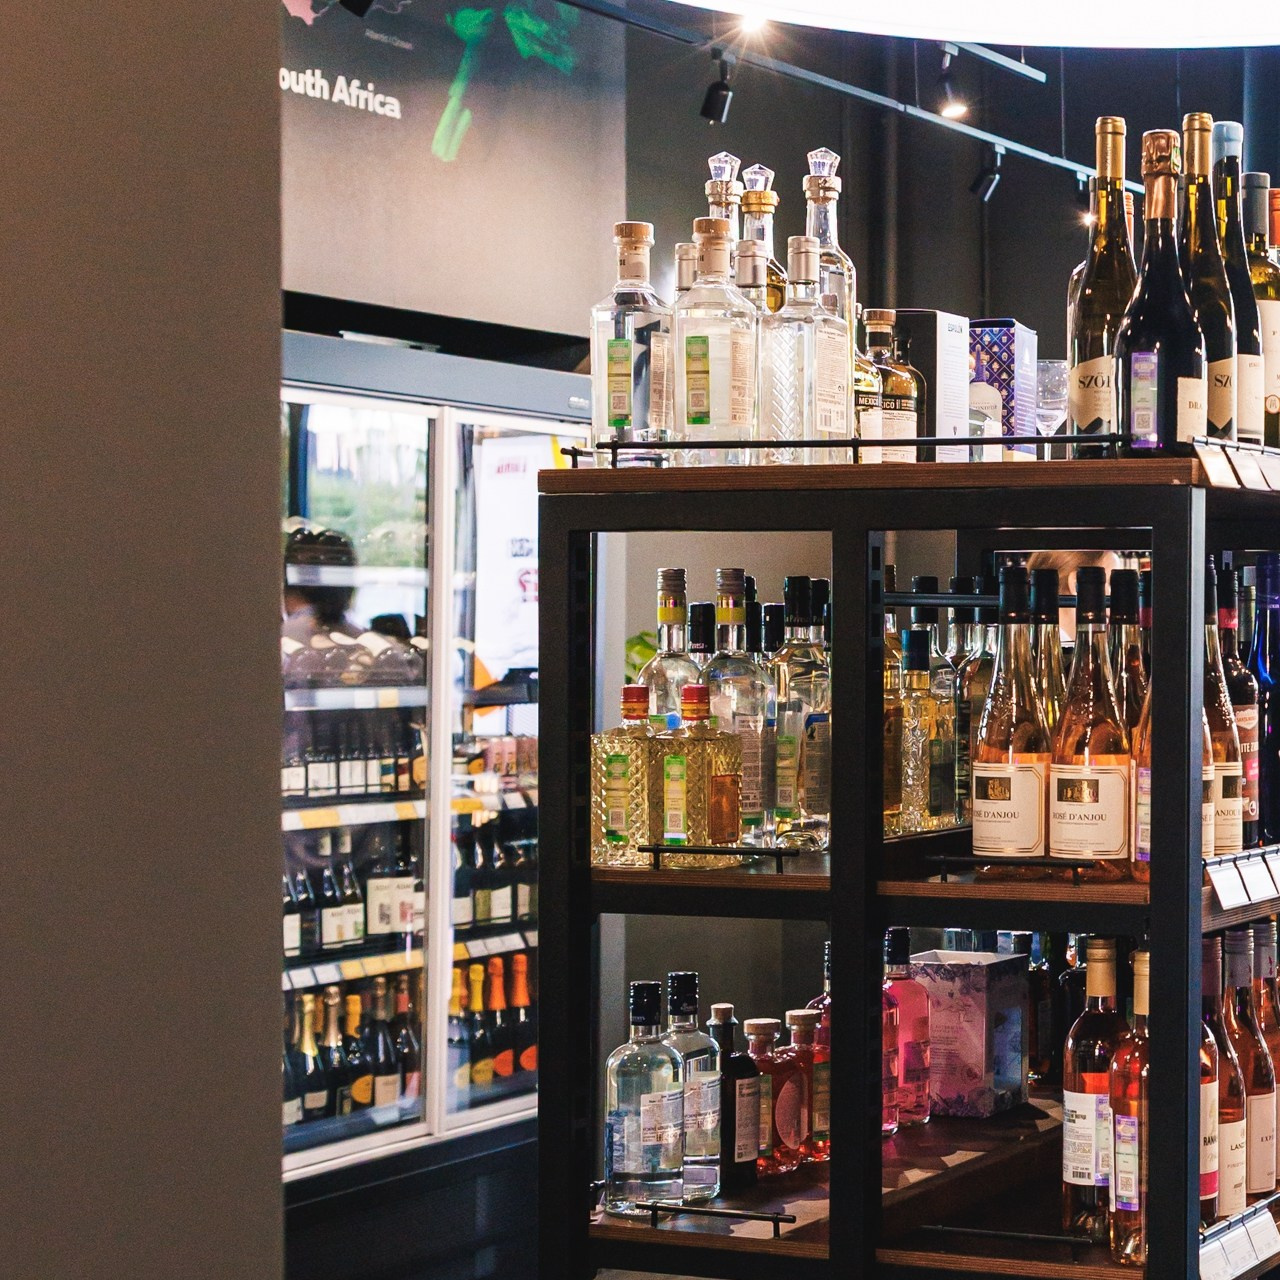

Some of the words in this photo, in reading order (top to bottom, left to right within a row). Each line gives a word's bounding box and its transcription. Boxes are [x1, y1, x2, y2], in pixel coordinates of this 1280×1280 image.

[332, 75, 403, 119] Africa
[983, 810, 1019, 819] D'ANJOU
[1068, 812, 1107, 821] D'ANJOU
